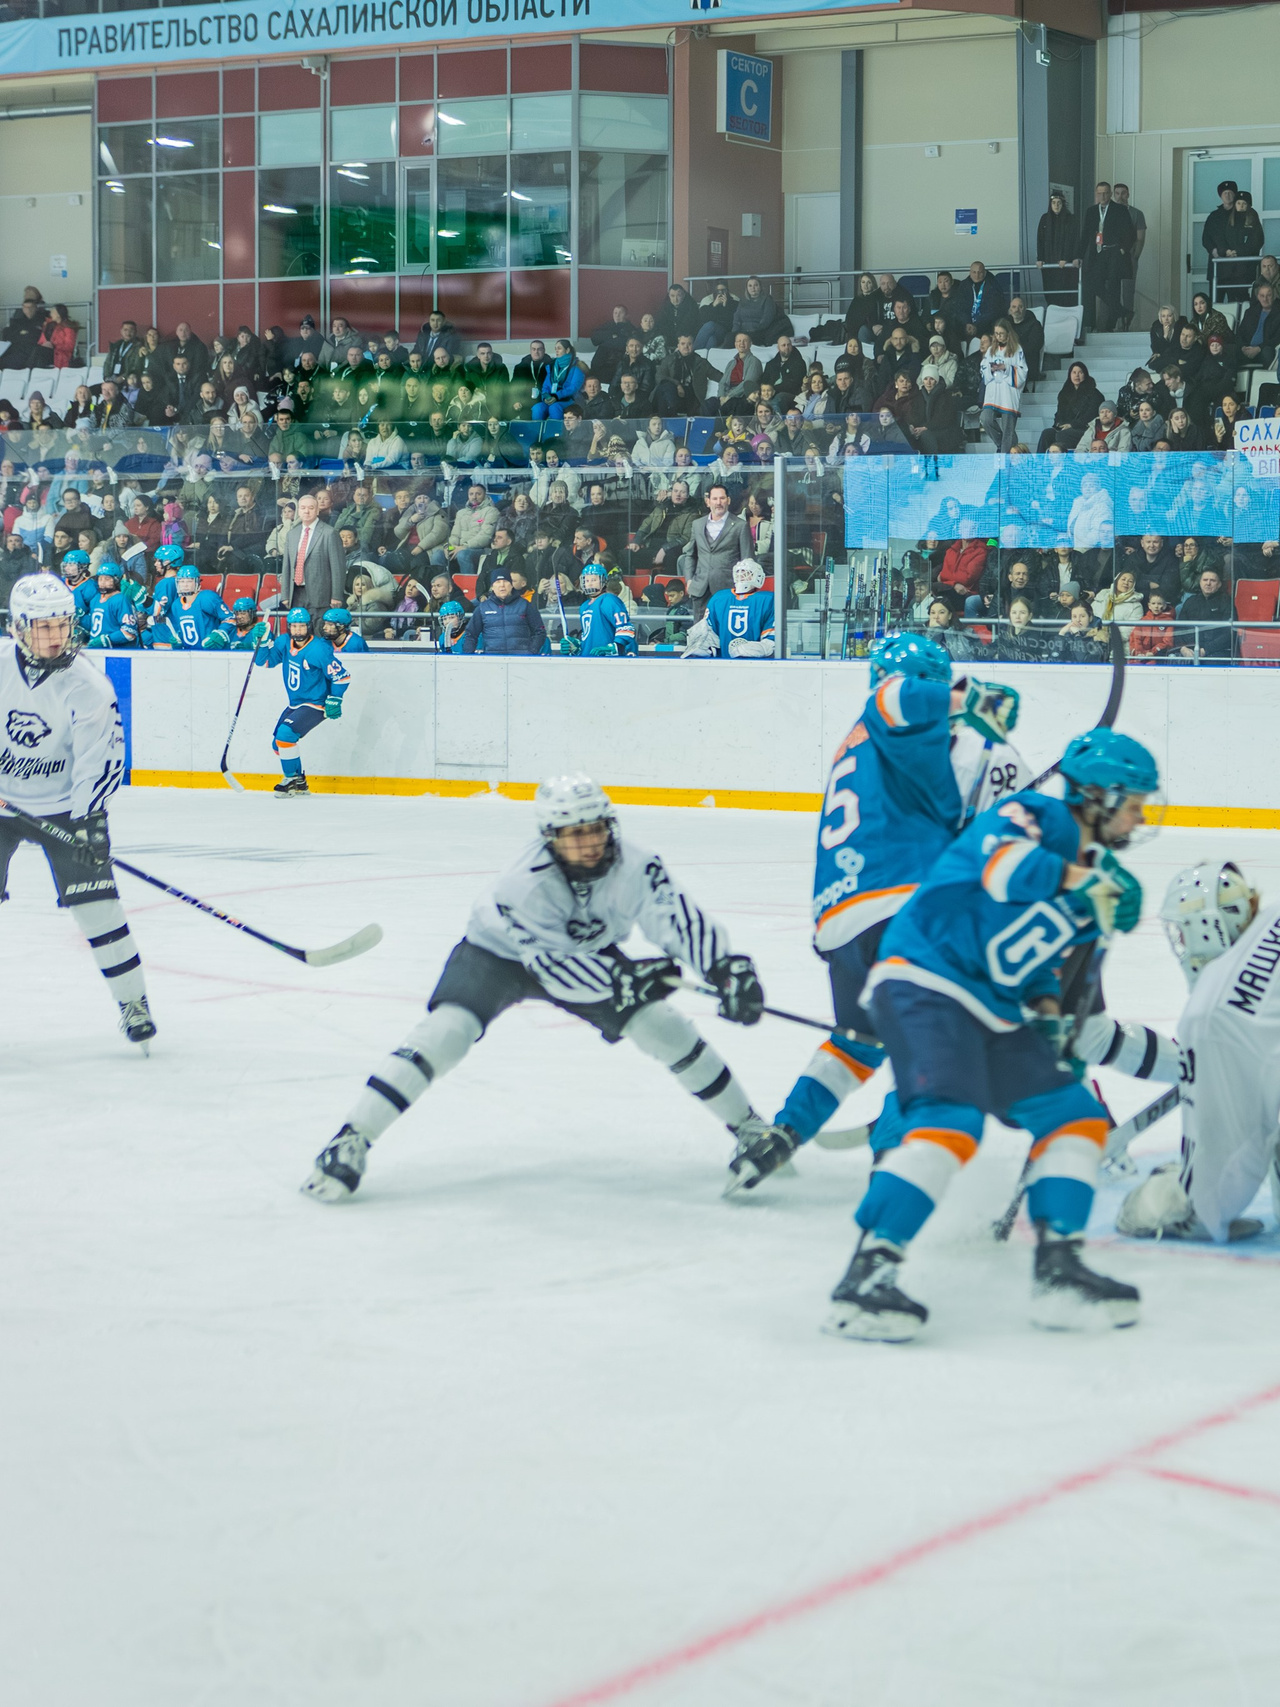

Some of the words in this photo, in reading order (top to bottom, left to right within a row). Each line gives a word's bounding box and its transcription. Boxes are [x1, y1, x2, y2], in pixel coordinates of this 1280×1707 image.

[57, 13, 259, 58] ПРАВИТЕЛЬСТВО
[730, 56, 769, 78] СЕКТОР
[728, 114, 768, 136] SECTOR
[613, 612, 628, 626] 17
[326, 660, 342, 676] 43
[989, 762, 1018, 797] 98
